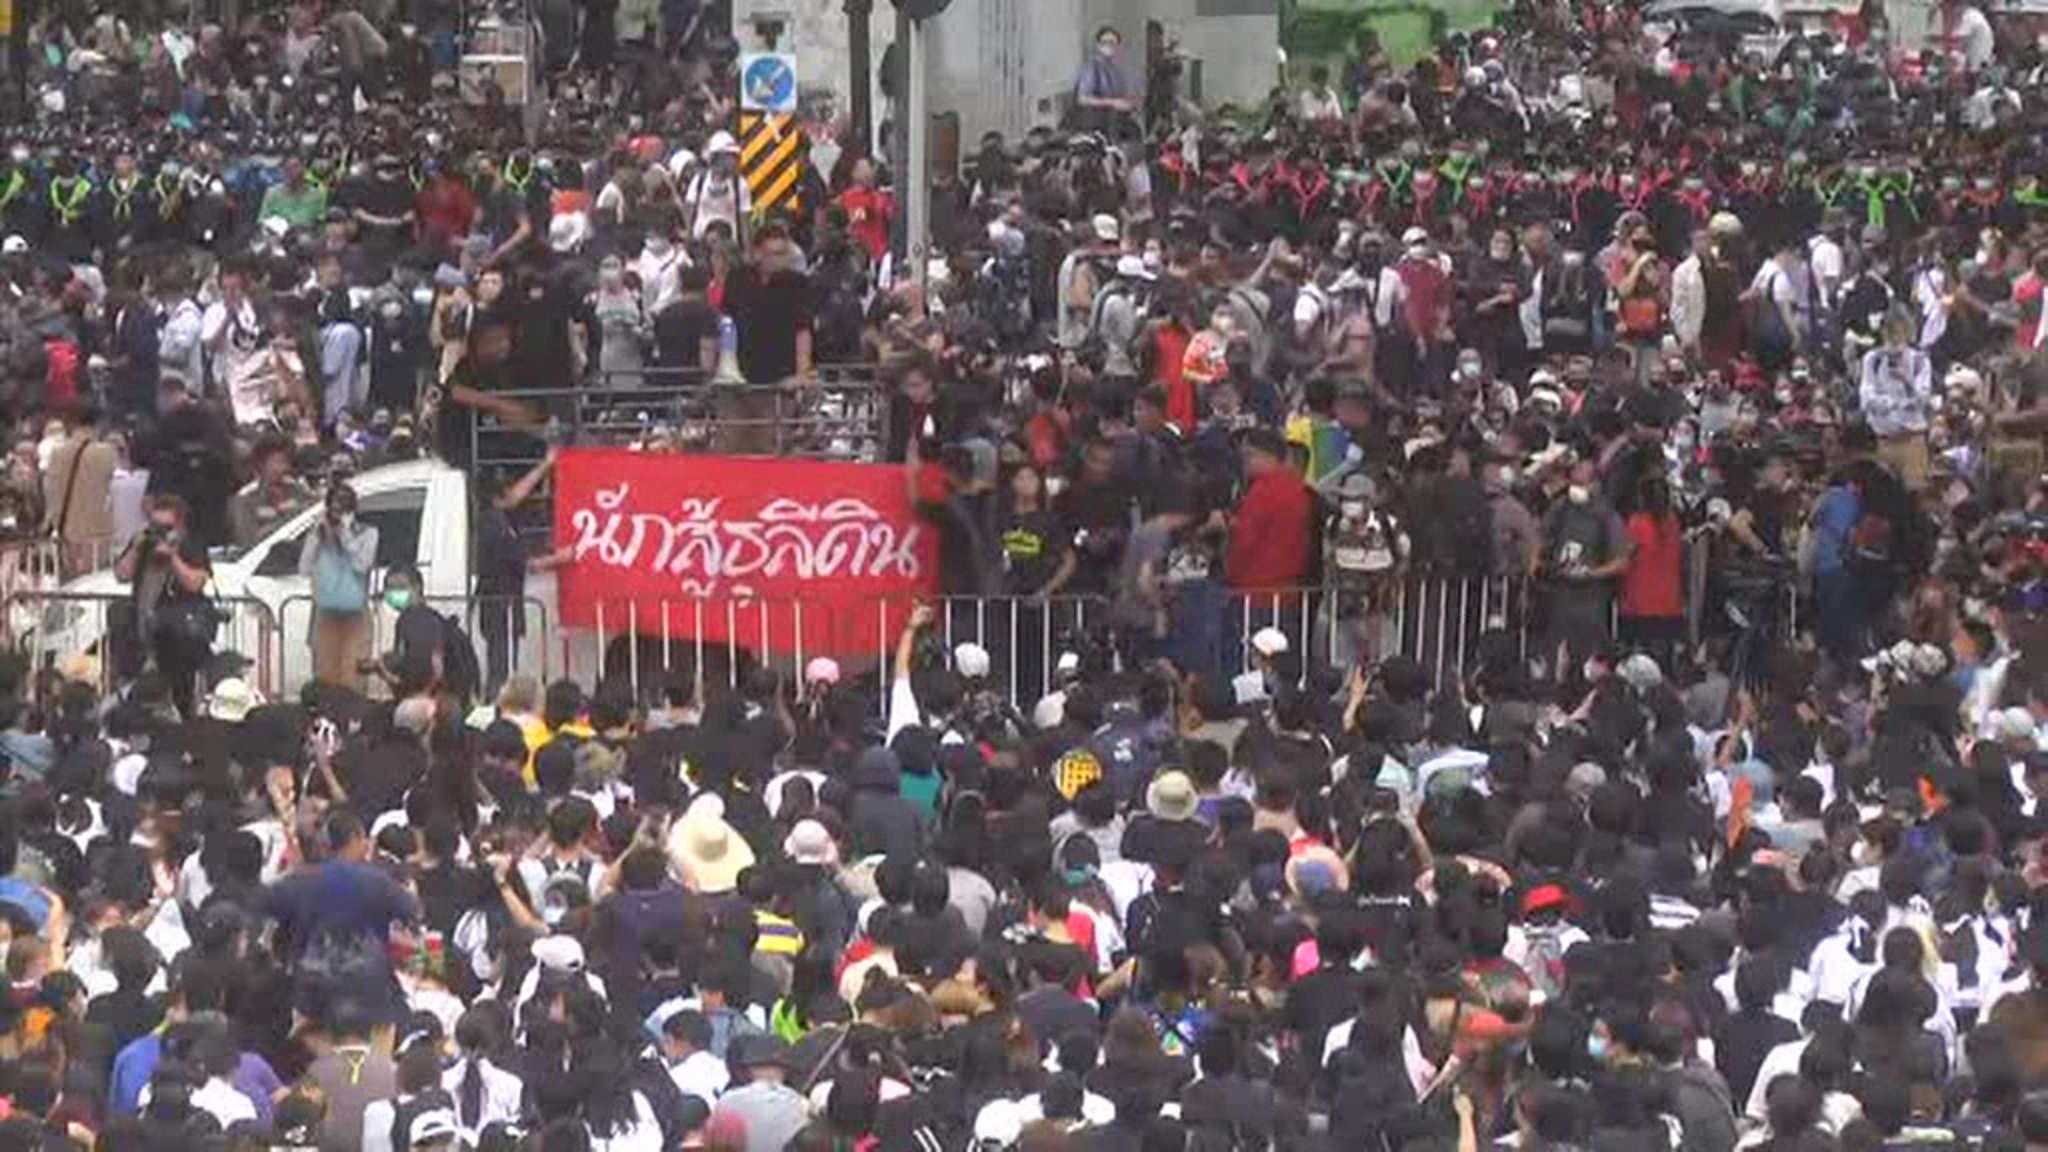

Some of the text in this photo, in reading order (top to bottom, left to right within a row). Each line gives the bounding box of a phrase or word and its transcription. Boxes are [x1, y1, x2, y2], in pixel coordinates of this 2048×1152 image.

[573, 482, 920, 608] นักสู้ธุลีดิน
